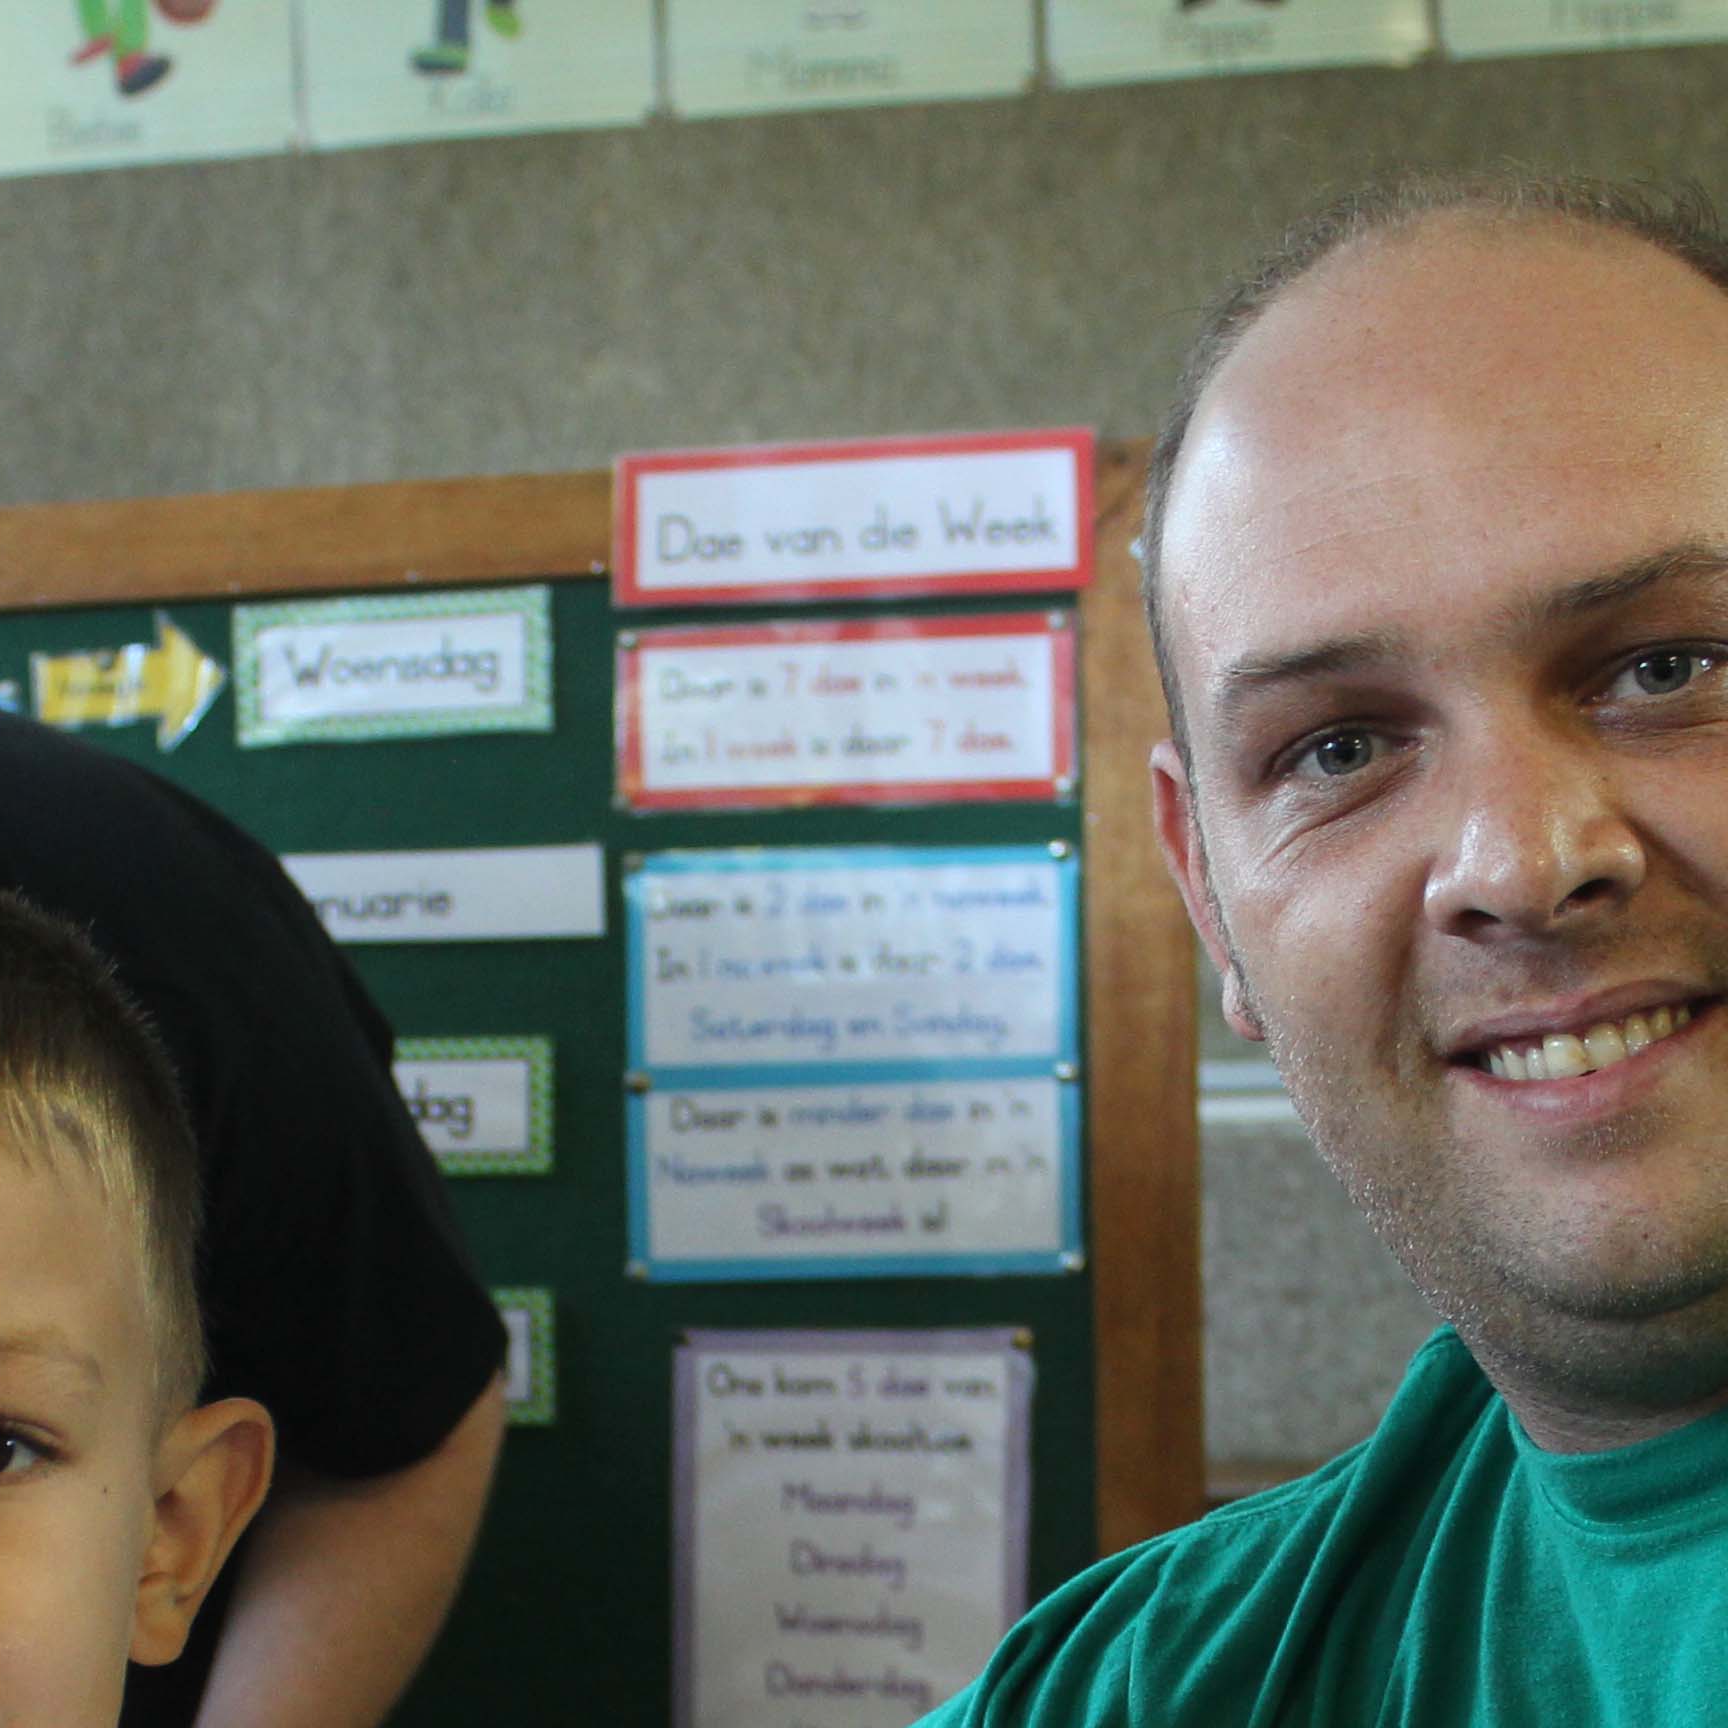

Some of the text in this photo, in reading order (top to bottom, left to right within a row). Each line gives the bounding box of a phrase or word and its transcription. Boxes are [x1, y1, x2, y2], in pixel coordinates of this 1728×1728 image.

[936, 494, 1059, 549] Week
[280, 636, 500, 692] Woensdag
[312, 878, 455, 921] nuarie
[408, 1076, 475, 1141] dag
